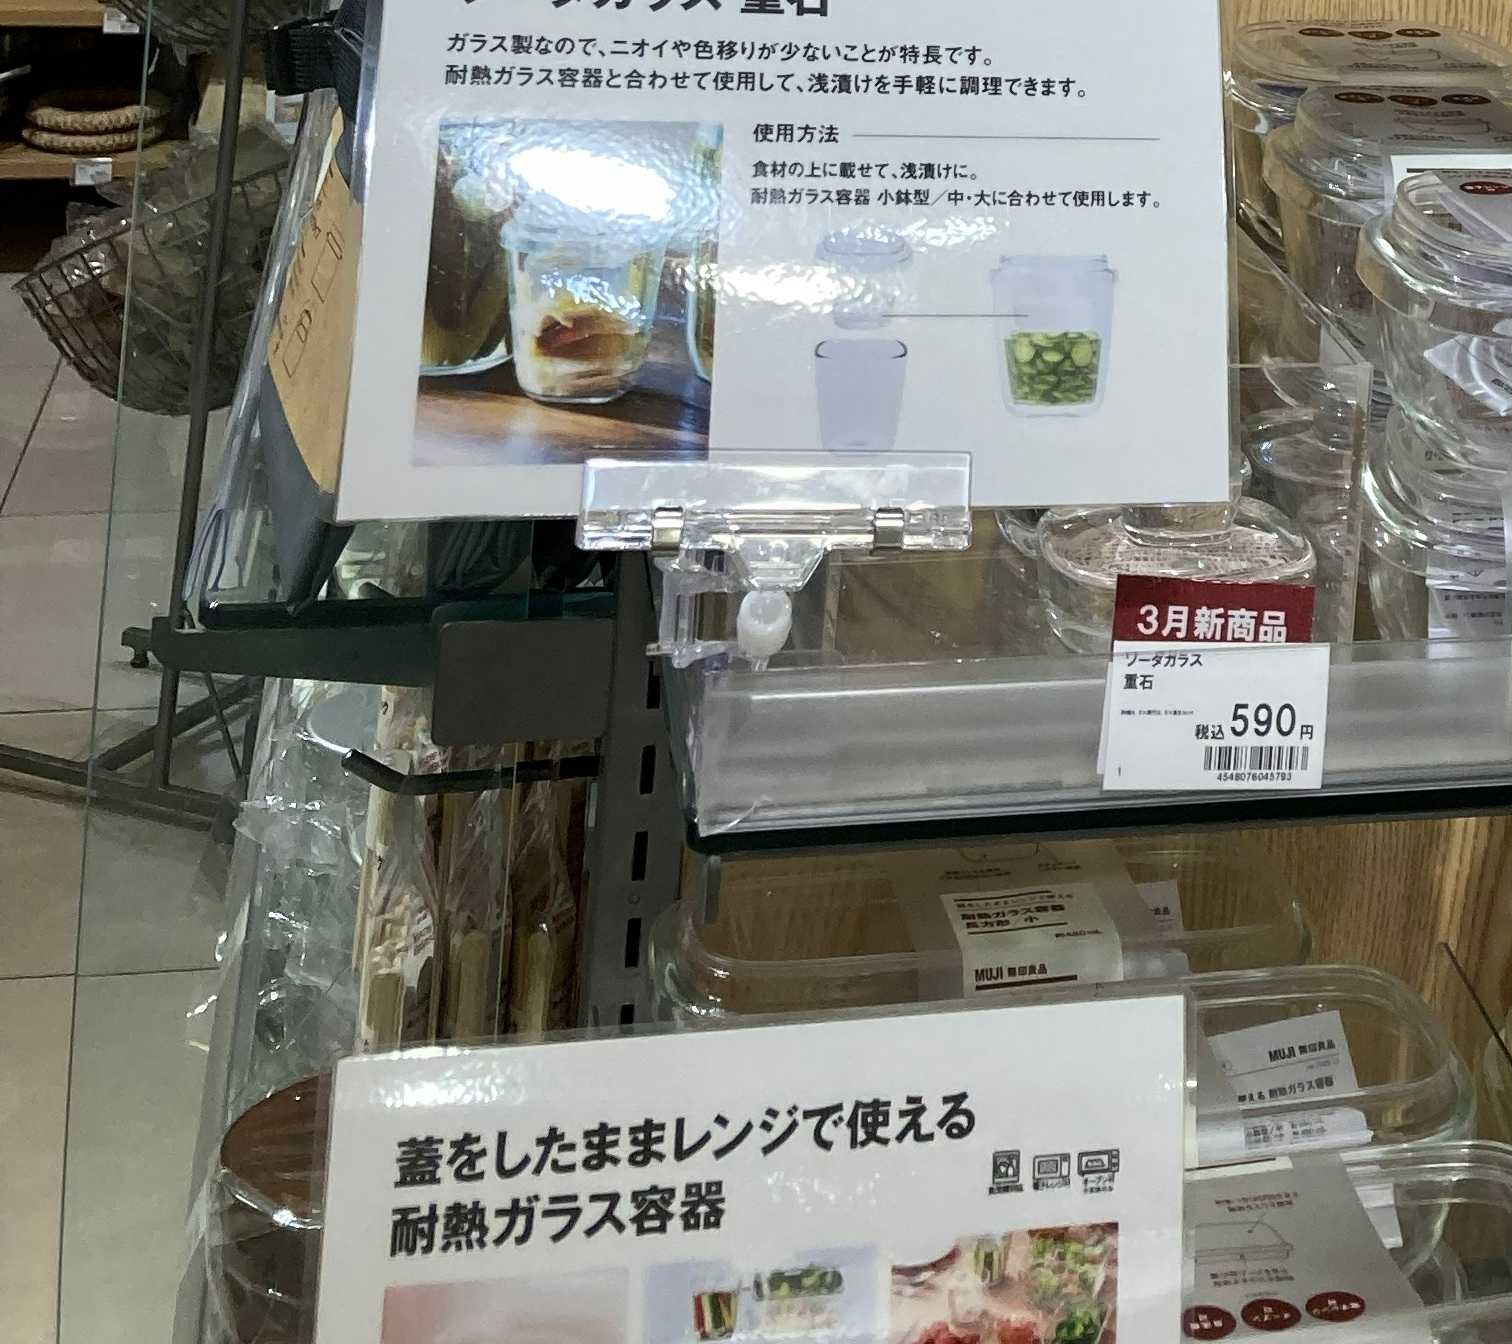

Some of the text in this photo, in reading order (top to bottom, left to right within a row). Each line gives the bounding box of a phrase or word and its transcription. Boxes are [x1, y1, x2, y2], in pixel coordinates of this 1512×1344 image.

[446, 32, 993, 67] ガラス製なので、ニオイや色移りが少ないことが特長です。
[444, 63, 1087, 99] 耐熱ガラス容器と合わせて使用して、浅漬けを手軽に調理できます。
[753, 123, 840, 145] 使用方法
[751, 160, 978, 182] 食材の上に載せて、浅漬けに。
[750, 188, 871, 207] 耐熱ガラス容器
[1137, 604, 1288, 643] 3月新商品
[1125, 652, 1203, 668] ソーダガラス
[1123, 673, 1154, 691] 重石
[975, 967, 1004, 982] MUJI
[1268, 1046, 1296, 1062] MUJI
[394, 1090, 977, 1188] 蓋をしたままレンジで使える
[389, 1181, 727, 1258] 耐熱ガラス容器
